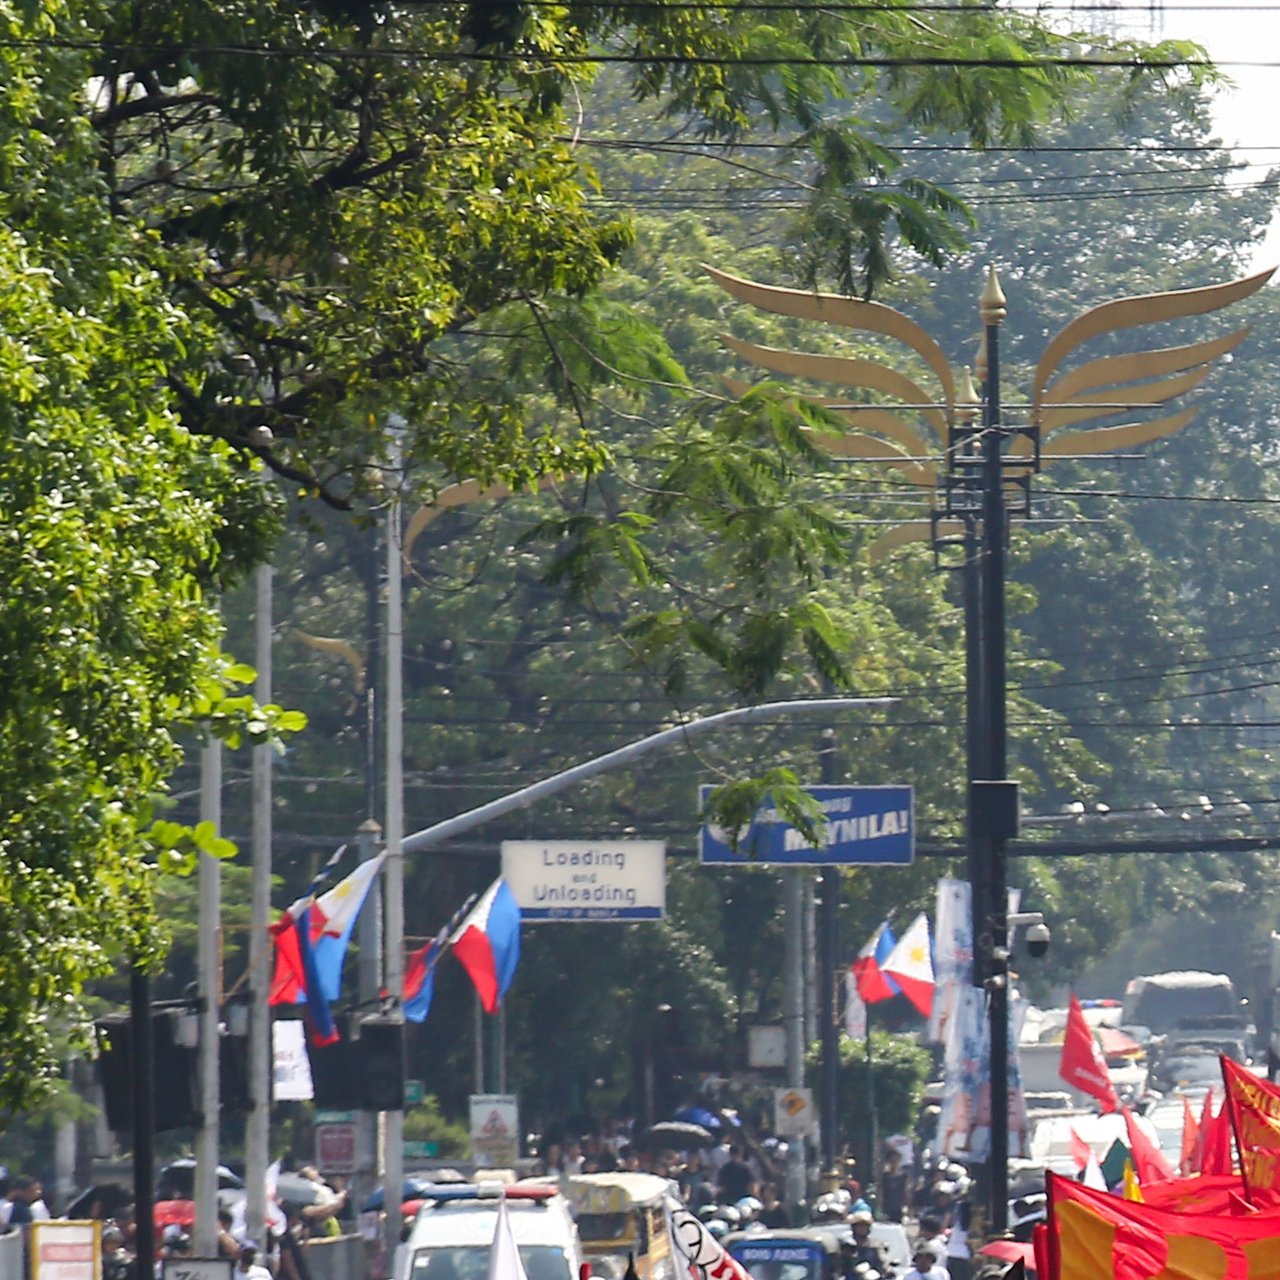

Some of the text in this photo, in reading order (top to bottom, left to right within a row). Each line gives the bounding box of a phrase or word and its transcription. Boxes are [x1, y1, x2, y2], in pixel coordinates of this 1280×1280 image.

[784, 809, 909, 853] MYNILA!
[543, 849, 625, 870] Loading
[572, 872, 598, 883] and
[533, 884, 636, 904] Unloading
